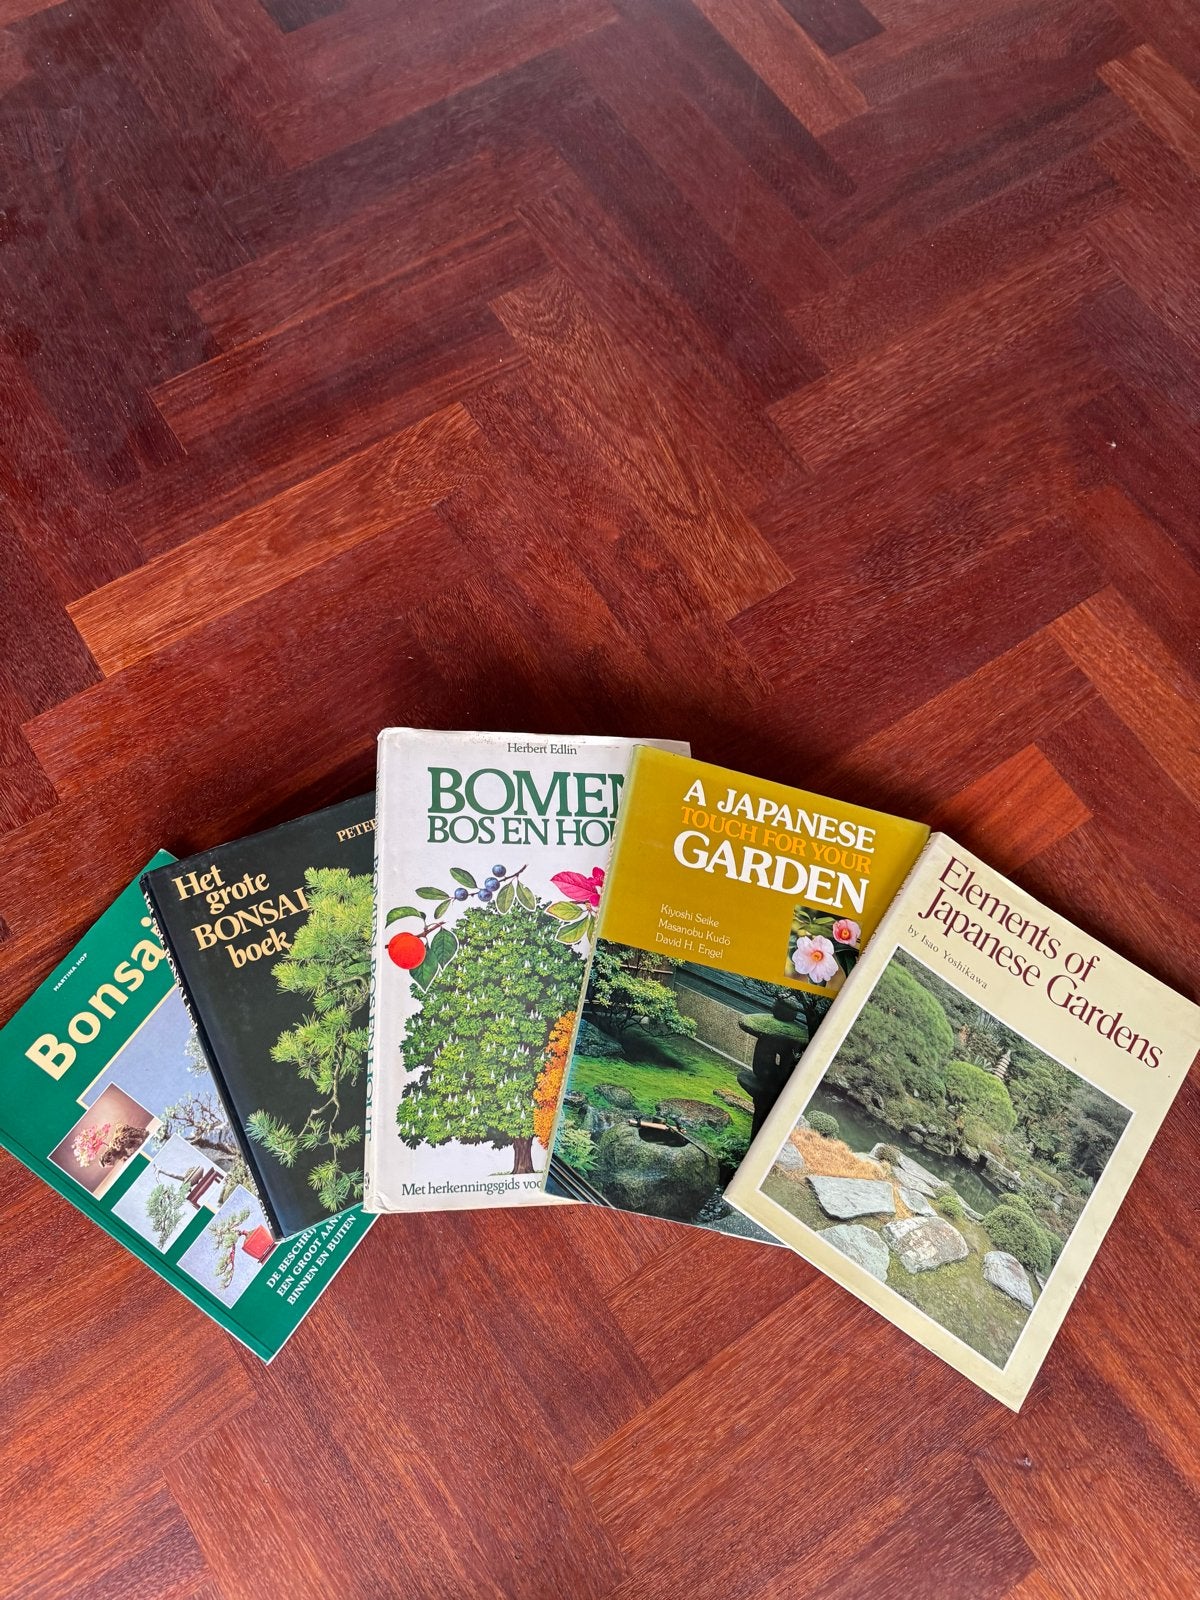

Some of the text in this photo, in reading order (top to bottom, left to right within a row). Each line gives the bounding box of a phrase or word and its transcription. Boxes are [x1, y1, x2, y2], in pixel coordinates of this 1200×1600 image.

[507, 742, 577, 755] Herbert Edlin
[427, 815, 495, 844] BOS
[502, 817, 549, 845] EN
[683, 779, 876, 854] A JAPANESE
[681, 806, 757, 843] TOUCH
[762, 830, 807, 857] FOR
[811, 842, 872, 874] YOUR
[171, 864, 226, 901] Het
[673, 830, 869, 914] GARDEN
[205, 873, 270, 915] grote
[660, 903, 720, 927] Kiyoshi Seike
[191, 887, 311, 951] BONSAI
[658, 918, 704, 939] Masanobu
[938, 855, 1062, 959] Elements
[1064, 952, 1101, 982] of
[225, 927, 293, 969] boek
[655, 932, 724, 959] David H. Engel
[907, 924, 988, 990] by Isao Yoshikawa
[53, 952, 88, 992] MARTINA HOP
[917, 887, 1041, 987] Japanese
[1046, 974, 1163, 1069] Gardens
[401, 1183, 426, 1196] Met
[428, 1180, 520, 1196] herkenningsgids
[266, 1271, 281, 1288] DE
[276, 1275, 295, 1297] EEN
[292, 1238, 322, 1275] GROOT
[286, 1214, 357, 1305] BINNEN EN BUITEN
